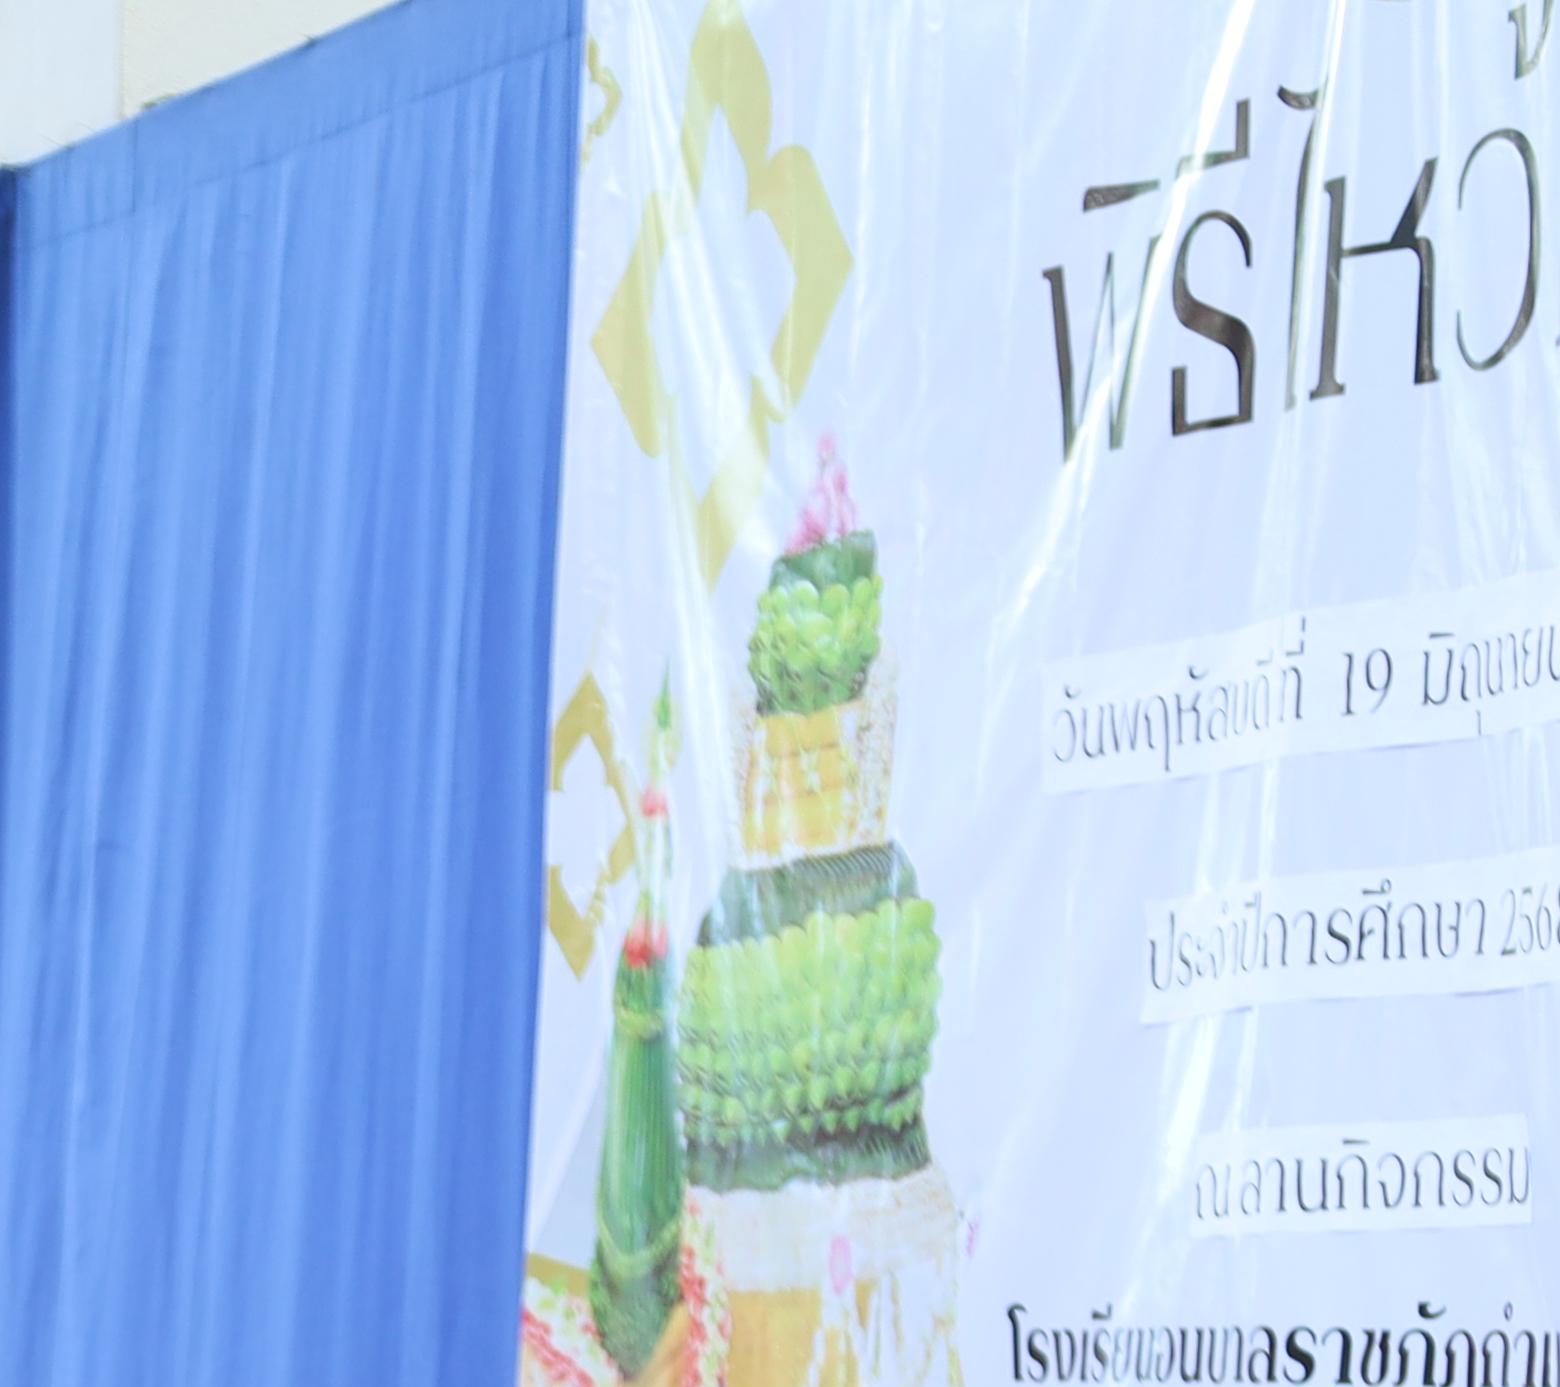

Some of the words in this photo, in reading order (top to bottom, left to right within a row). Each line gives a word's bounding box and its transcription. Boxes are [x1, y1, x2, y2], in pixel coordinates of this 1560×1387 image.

[1342, 647, 1393, 717] 19
[1148, 878, 1486, 992] ประจำปีการศึกษา
